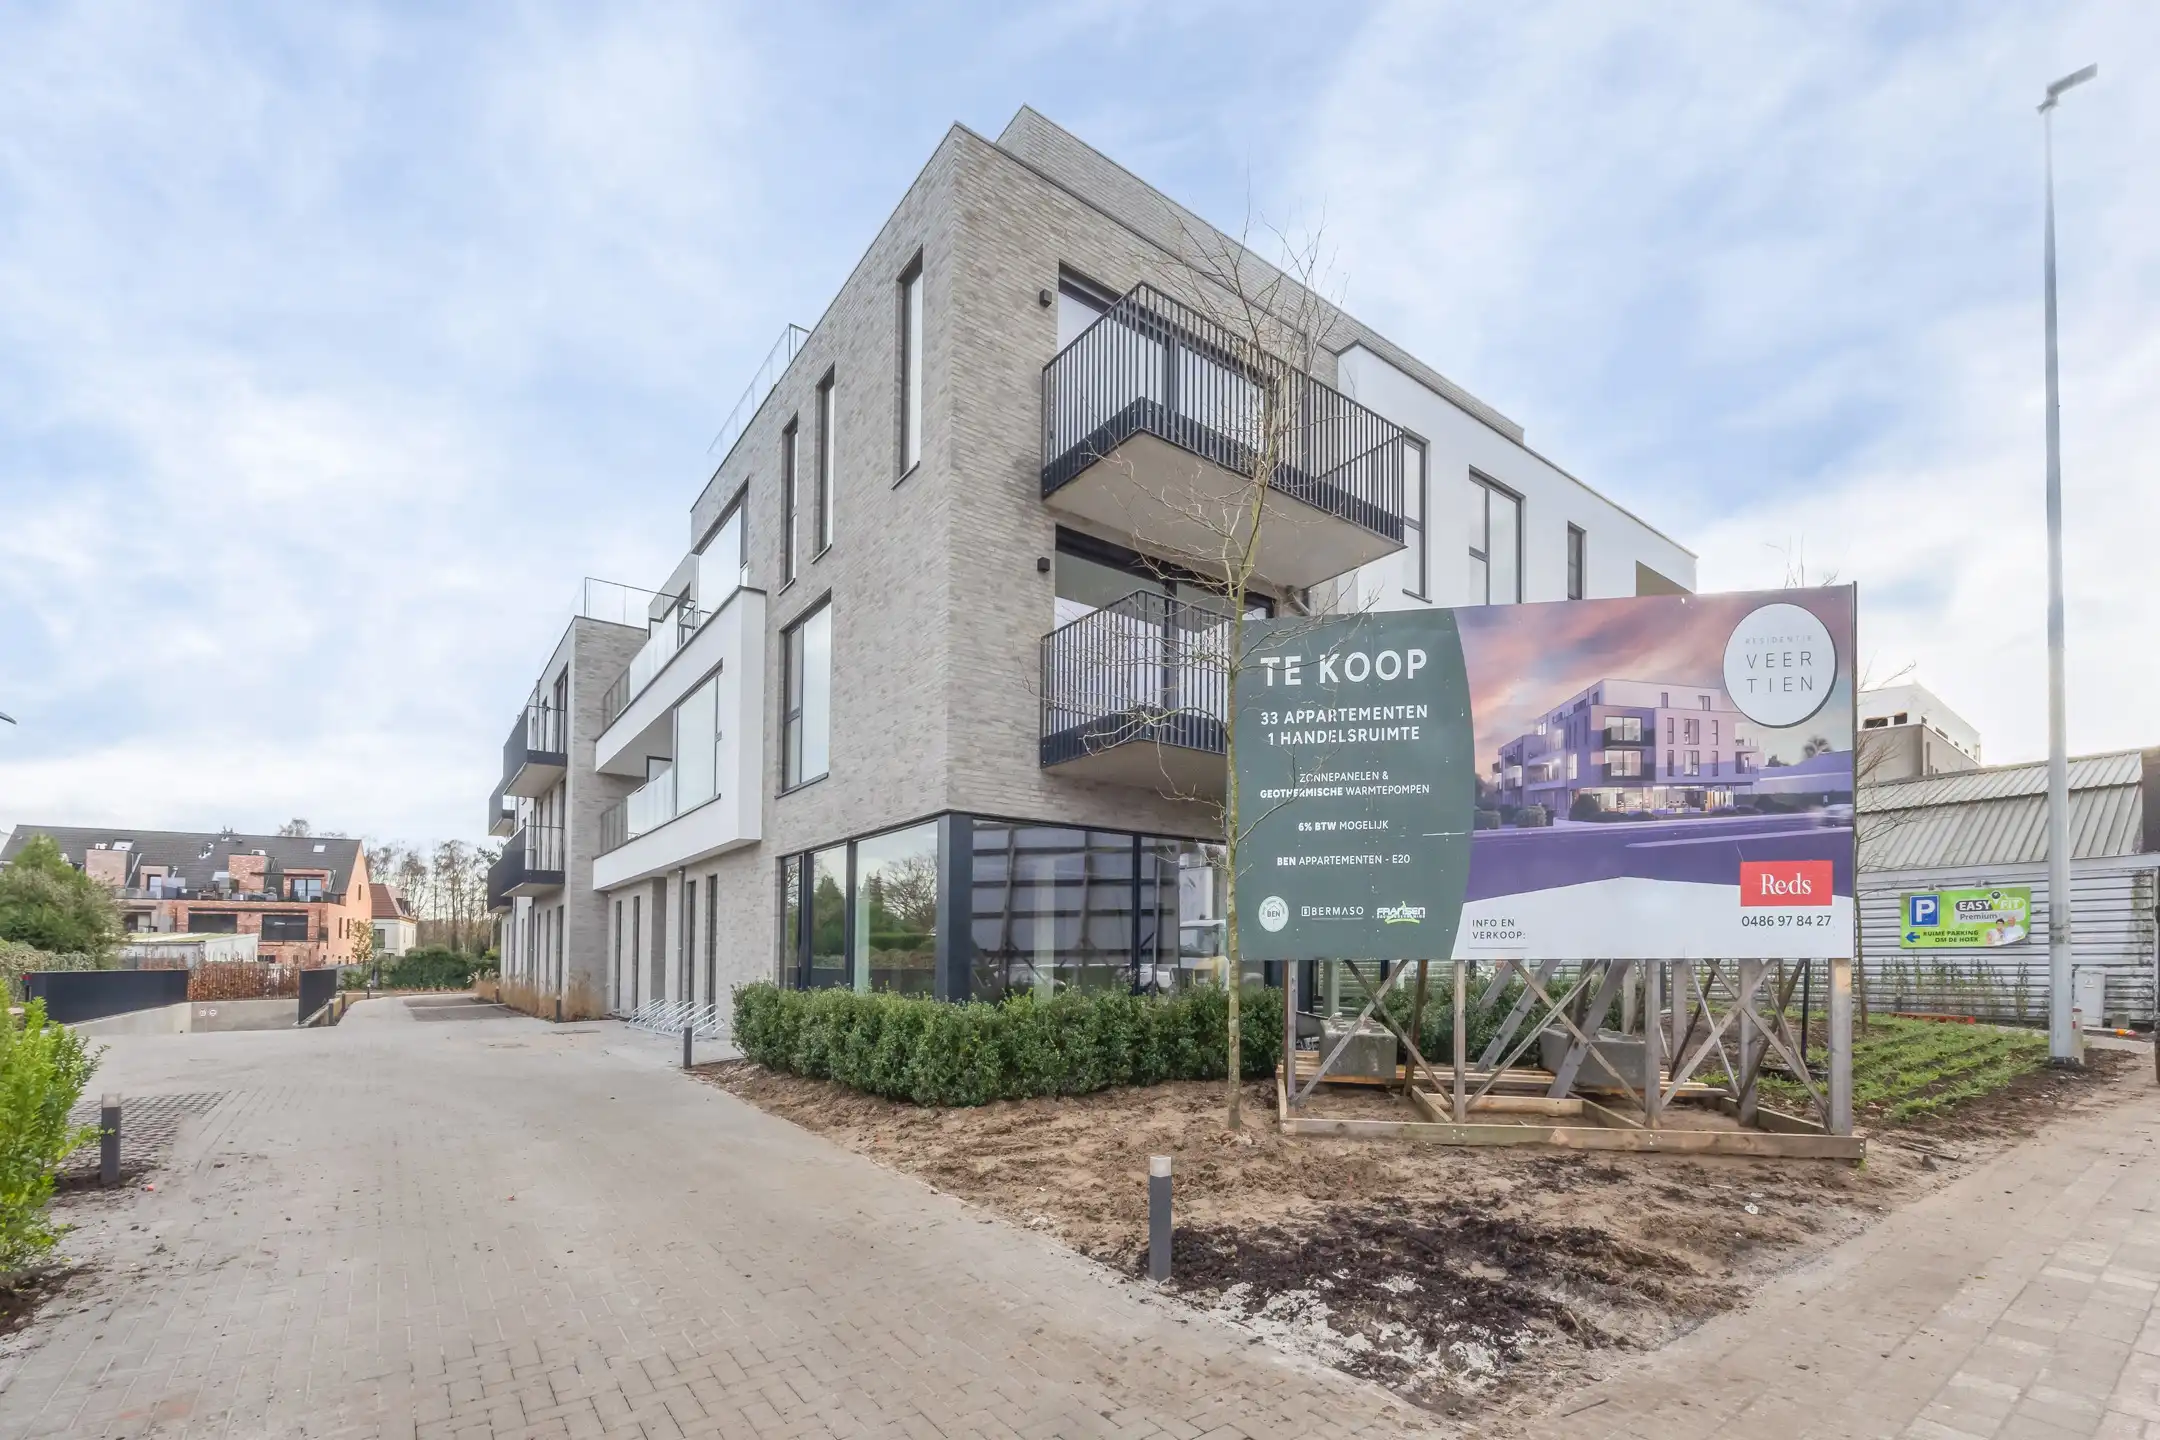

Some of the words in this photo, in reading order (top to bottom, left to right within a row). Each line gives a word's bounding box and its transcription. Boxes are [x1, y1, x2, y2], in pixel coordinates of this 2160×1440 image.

[1746, 651, 1812, 669] VEER
[1259, 655, 1302, 687] TE
[1319, 648, 1427, 684] KOOP
[1746, 675, 1813, 694] TIEN
[1260, 712, 1279, 725] 33
[1284, 704, 1428, 725] APPARTEMENTEN
[1268, 732, 1275, 746] 1
[1280, 726, 1420, 746] HANDELSRUIMTE
[1300, 771, 1379, 783] ZONNEPANELEN
[1382, 771, 1389, 781] &
[1260, 786, 1343, 799] GEOTHERMISCHE
[1346, 784, 1430, 796] WARMTEPOMPEN
[1298, 822, 1312, 832] 6%
[1315, 822, 1336, 832] BTW
[1339, 820, 1389, 831] MOGELIJK
[1277, 856, 1296, 866] BEN
[1299, 855, 1382, 866] APPARTEMENTEN
[1392, 854, 1410, 864] E20
[1760, 872, 1812, 896] Reds
[1311, 906, 1364, 916] BERMASO
[1915, 899, 1936, 923] P
[1958, 901, 1991, 911] EASY
[1266, 910, 1281, 918] BEN
[1741, 915, 1775, 927] 0486
[1778, 915, 1793, 926] 97
[1796, 915, 1813, 926] 84
[1816, 914, 1832, 926] 27
[1472, 919, 1497, 928] INFO
[1501, 919, 1515, 928] EN
[1472, 930, 1526, 940] VERKOOP:
